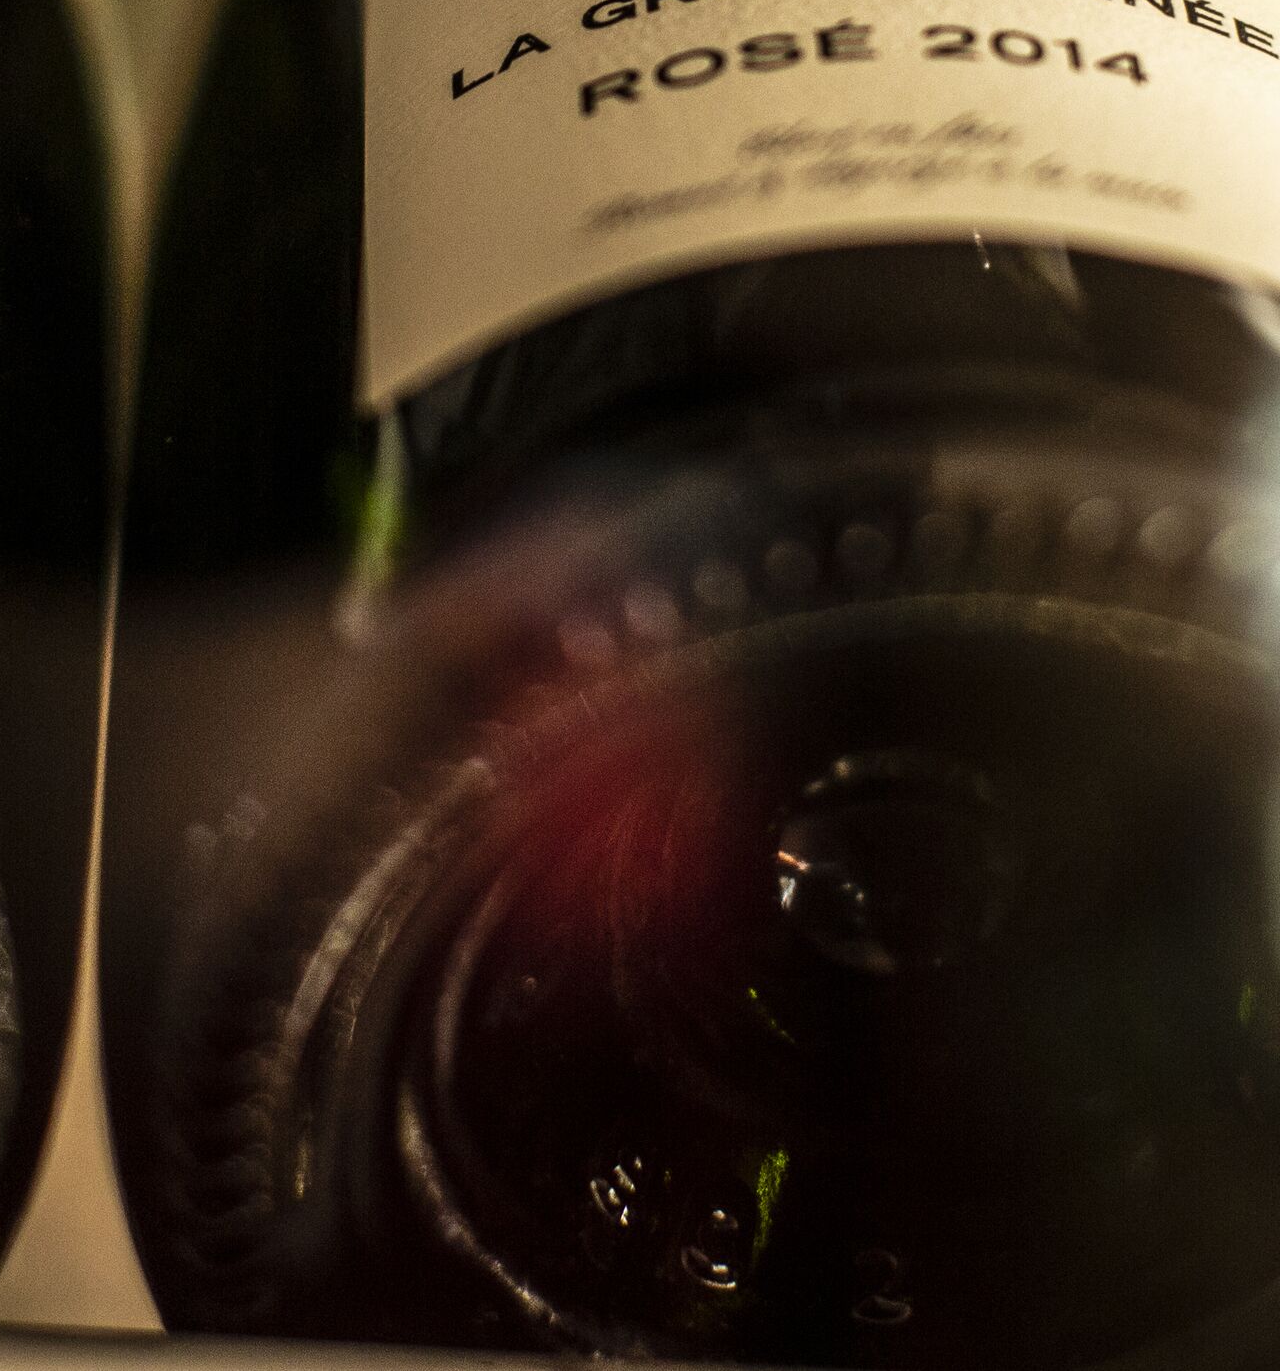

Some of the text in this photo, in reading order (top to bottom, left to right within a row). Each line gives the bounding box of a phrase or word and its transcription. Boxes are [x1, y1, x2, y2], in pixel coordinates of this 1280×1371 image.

[450, 31, 553, 101] LA
[577, 18, 1150, 120] ROSÉ 2014
